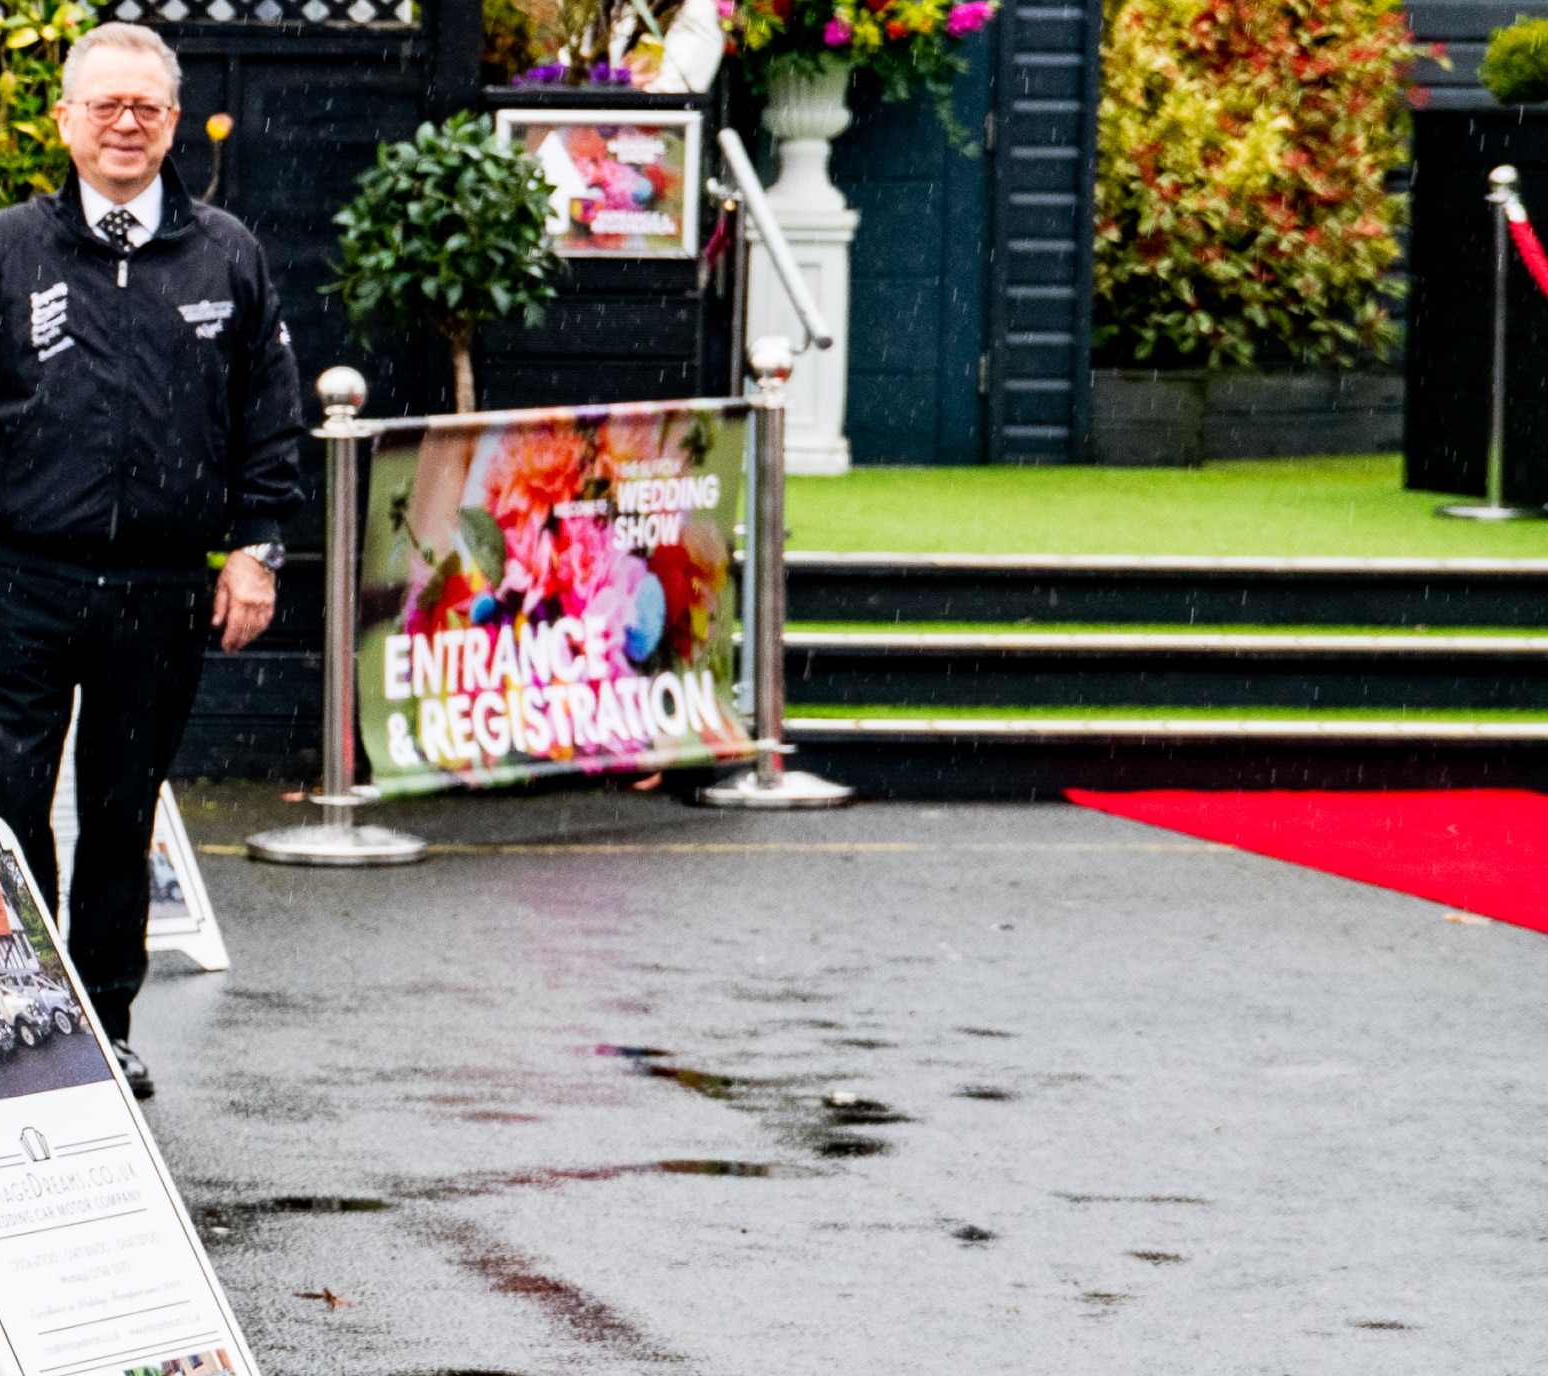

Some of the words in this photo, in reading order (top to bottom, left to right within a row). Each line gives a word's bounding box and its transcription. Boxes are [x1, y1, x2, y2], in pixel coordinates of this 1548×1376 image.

[617, 474, 719, 513] WEDDING
[613, 513, 681, 550] SHOW
[384, 616, 607, 699] ENTRANCE
[387, 712, 421, 767] &
[418, 671, 720, 762] REGISTRATION
[34, 1206, 56, 1221] CAR
[56, 1198, 94, 1216] MOTOR
[94, 1190, 142, 1210] COMPANY
